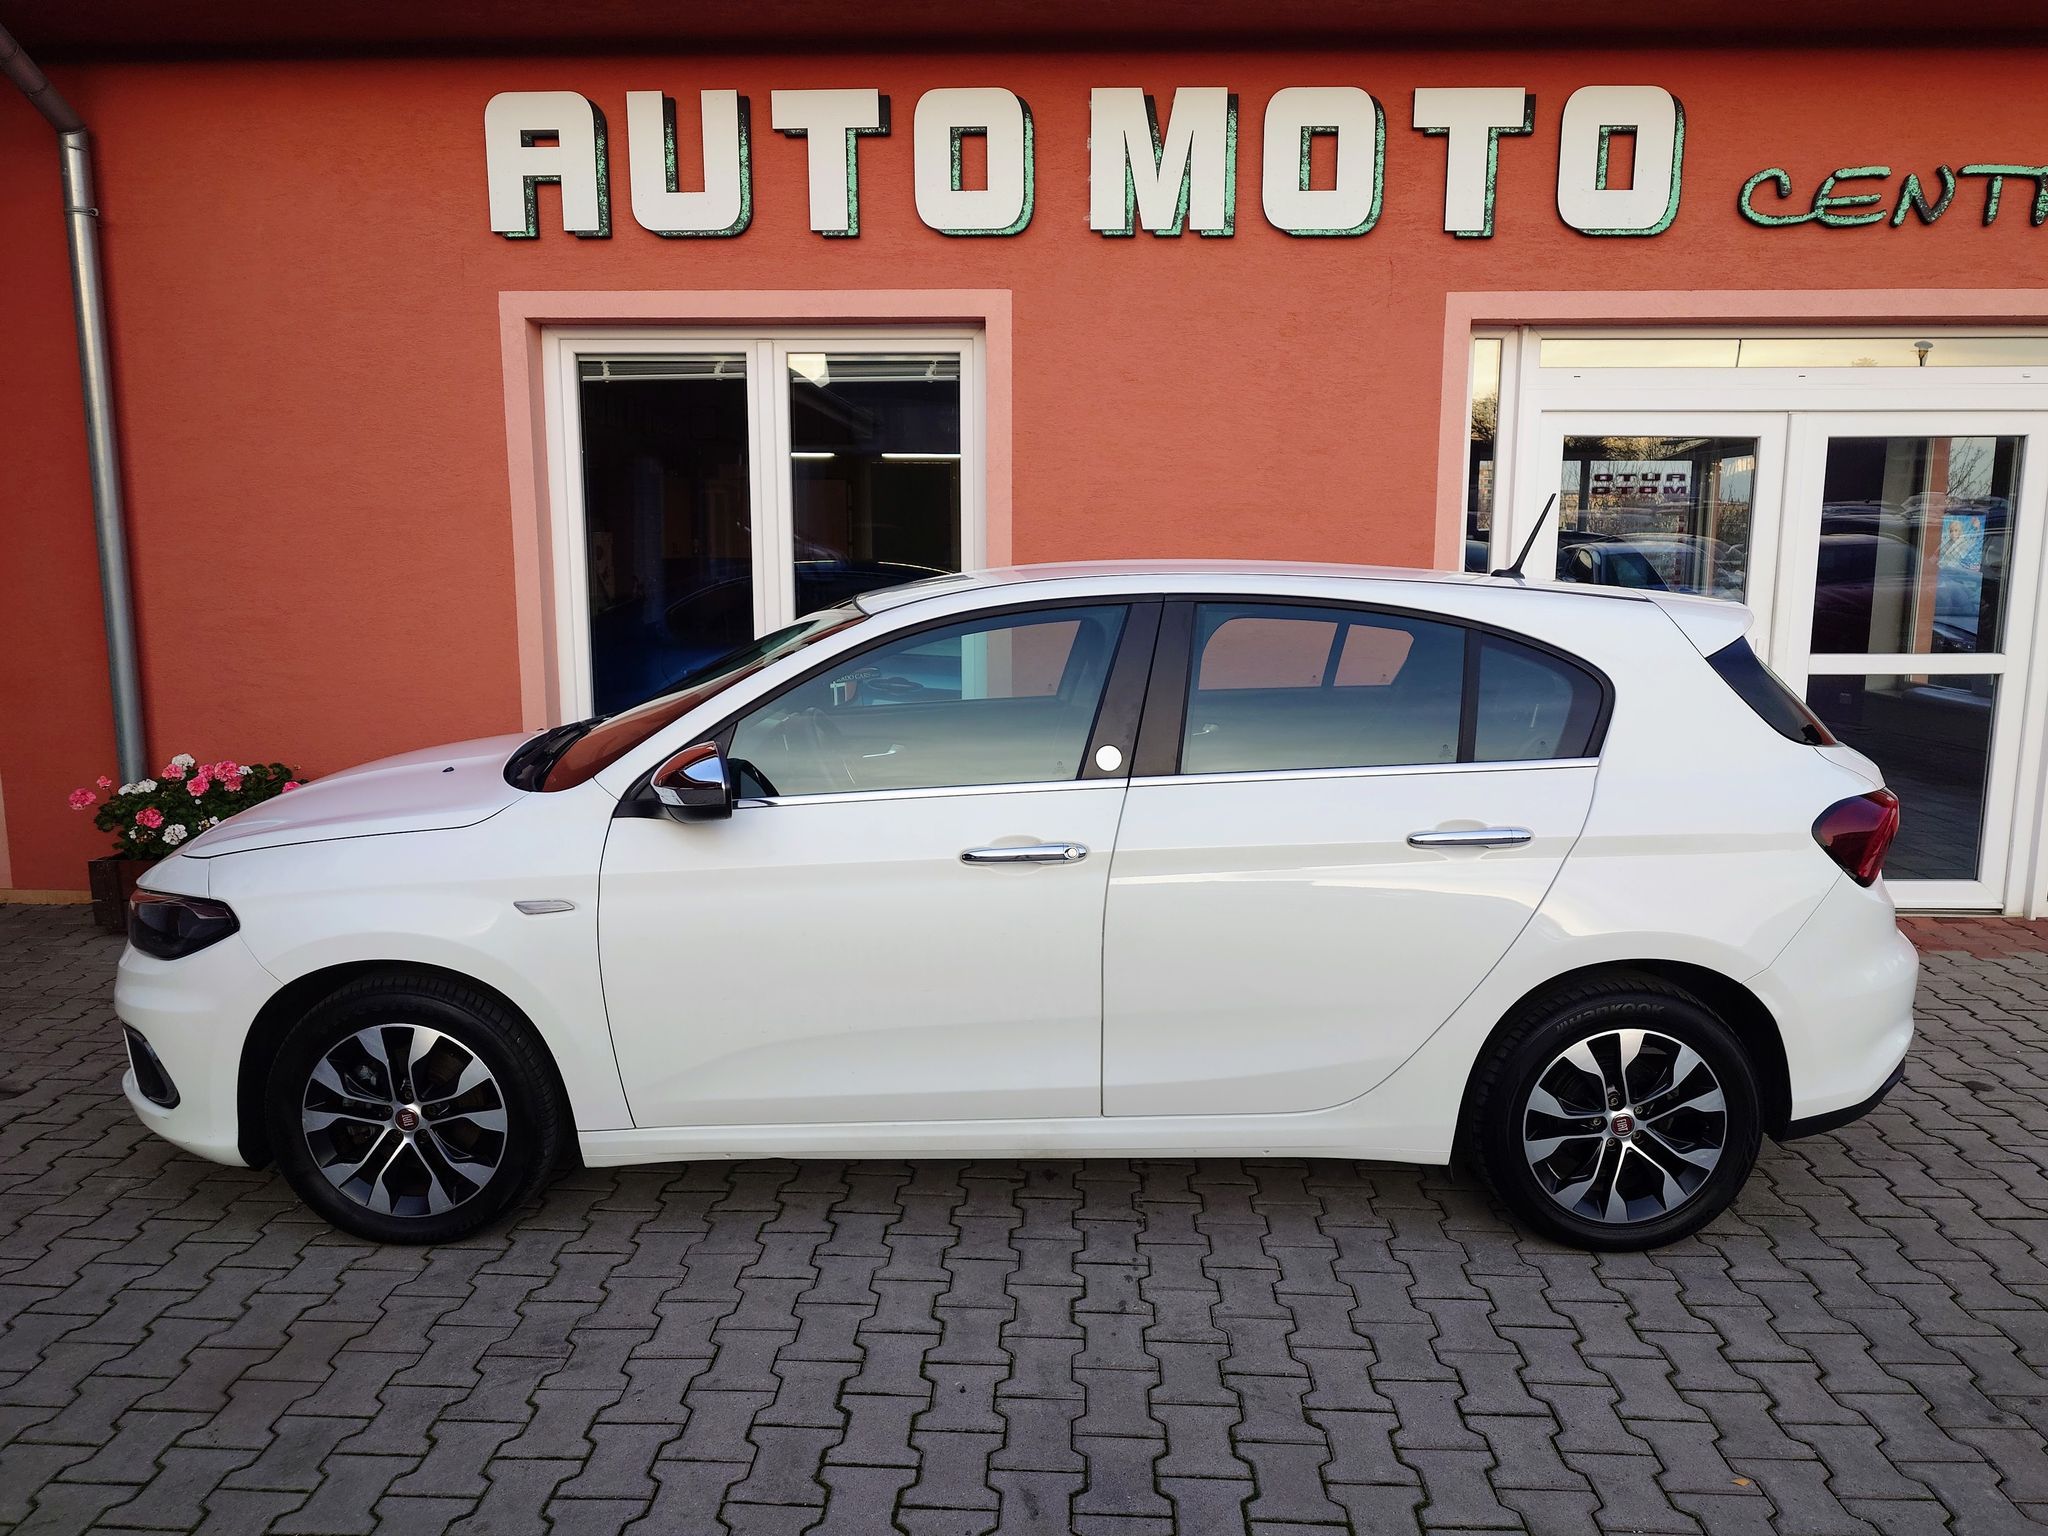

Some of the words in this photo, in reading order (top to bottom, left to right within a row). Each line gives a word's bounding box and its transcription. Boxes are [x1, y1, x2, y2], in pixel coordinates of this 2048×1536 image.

[485, 87, 1034, 239] AUTO
[1089, 84, 1687, 238] MOTO
[401, 1113, 414, 1126] FIAT
[1616, 1118, 1629, 1132] FIAT
